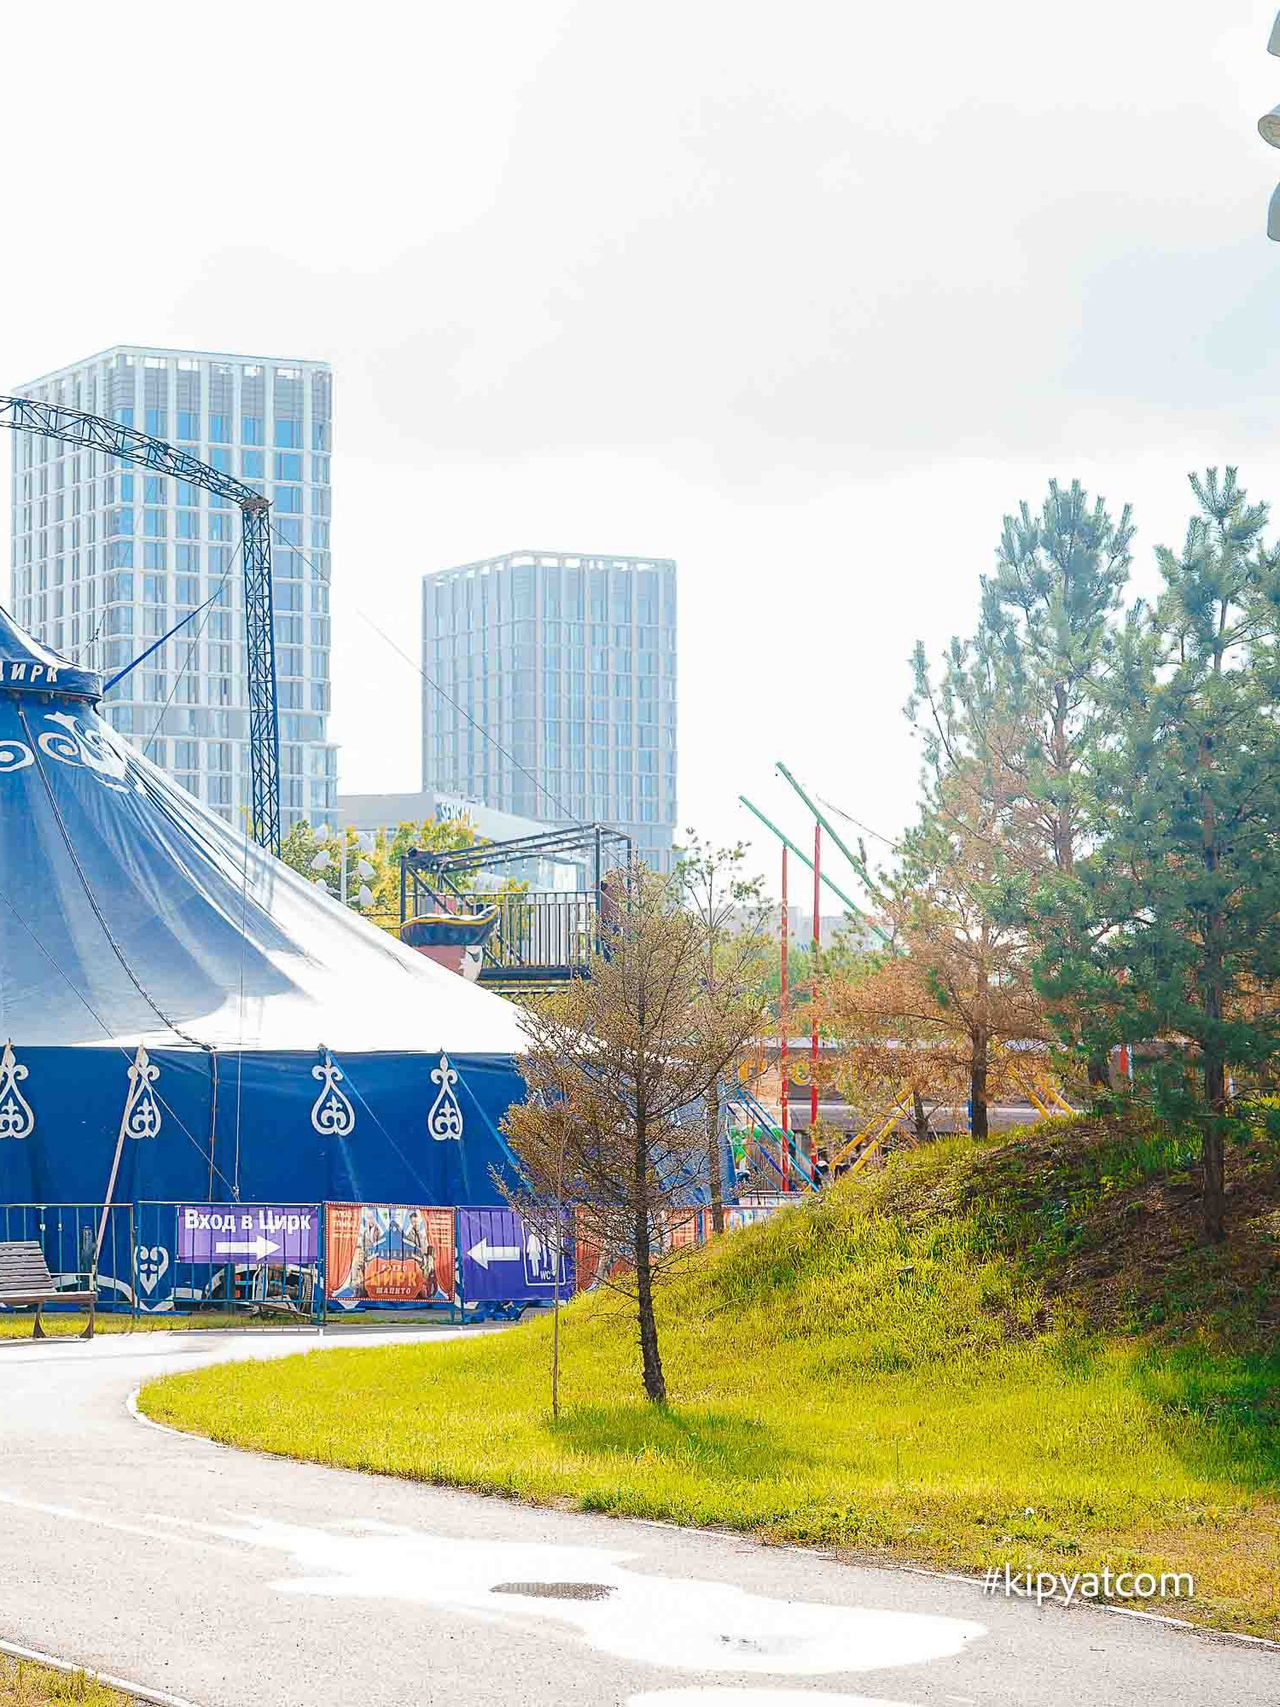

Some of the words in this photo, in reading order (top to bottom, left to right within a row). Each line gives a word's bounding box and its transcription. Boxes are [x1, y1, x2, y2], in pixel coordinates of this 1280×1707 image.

[184, 1208, 236, 1233] Вход
[241, 1214, 253, 1230] в
[259, 1209, 311, 1235] Цирк
[540, 1270, 551, 1280] WC
